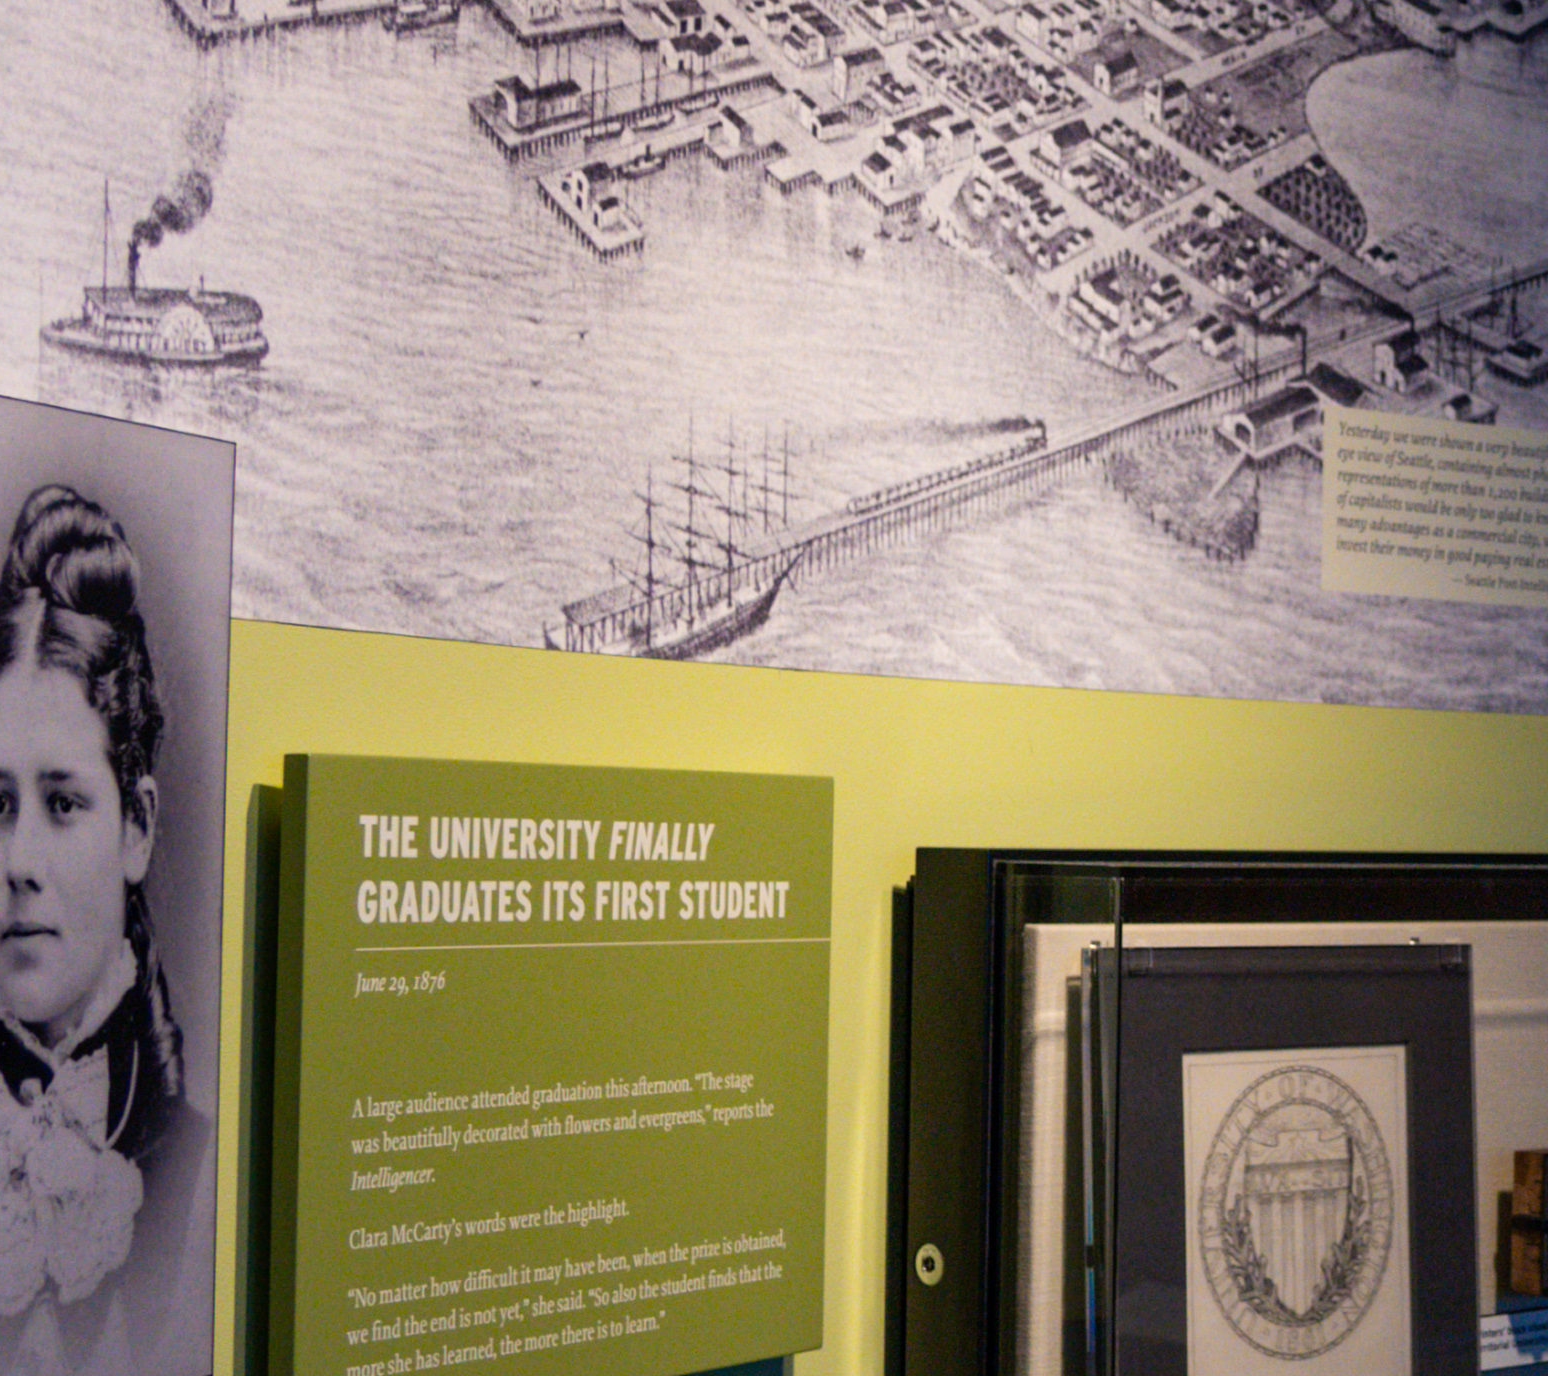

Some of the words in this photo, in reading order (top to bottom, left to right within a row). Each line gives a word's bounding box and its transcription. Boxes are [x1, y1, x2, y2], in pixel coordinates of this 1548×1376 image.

[1337, 448, 1354, 462] eye
[1357, 448, 1382, 463] view
[1384, 451, 1396, 466] of
[1397, 451, 1435, 471] Seattle,
[1338, 422, 1390, 444] Yesterday
[1393, 433, 1408, 443] we
[1411, 434, 1437, 446] were
[1485, 443, 1509, 458] very
[1337, 470, 1417, 491] representations
[1420, 476, 1432, 495] of
[1432, 481, 1458, 494] more
[1461, 481, 1485, 497] than
[1336, 491, 1347, 507] of
[1348, 493, 1402, 512] capitalists
[1405, 499, 1438, 515] would
[1440, 500, 1452, 516] be
[1453, 504, 1477, 521] only
[1336, 516, 1367, 531] many
[1370, 517, 1431, 539] advantages
[1370, 539, 1395, 555] their
[1397, 544, 1432, 562] money
[1446, 548, 1472, 566] good
[1474, 551, 1511, 569] paying
[359, 815, 418, 858] THE
[430, 817, 600, 860] UNIVERSITY
[609, 822, 714, 861] FINALLY
[357, 880, 531, 923] GRADUATES
[543, 881, 585, 921] ITS
[596, 881, 670, 920] FIRST
[679, 882, 789, 919] STUDENT
[354, 973, 385, 998] June
[389, 975, 409, 995] 29,
[413, 971, 445, 991] 1876
[352, 1099, 364, 1118] A
[367, 1097, 403, 1122] large
[406, 1092, 469, 1115] audience
[471, 1086, 530, 1109] attended
[532, 1080, 602, 1110] graduation
[606, 1078, 629, 1098] this
[632, 1077, 693, 1096] afternoon.
[695, 1072, 723, 1090] "The
[724, 1073, 754, 1093] stage
[352, 1138, 379, 1154] was
[383, 1126, 461, 1151] beautifully
[464, 1120, 529, 1144] decorated
[531, 1117, 562, 1138] with
[565, 1115, 611, 1135] flowers
[614, 1110, 636, 1131] and
[639, 1105, 711, 1131] evergreens,"
[713, 1104, 754, 1126] reports
[756, 1099, 774, 1118] the
[350, 1167, 436, 1193] Intelligencer.
[349, 1229, 388, 1249] Clara
[391, 1219, 462, 1245] McCarty's
[465, 1212, 506, 1235] words
[509, 1213, 541, 1230] were
[544, 1206, 565, 1225] the
[568, 1198, 629, 1227] highlight.
[348, 1287, 376, 1308] "No
[380, 1283, 428, 1304] matter
[430, 1277, 462, 1297] how
[464, 1266, 518, 1292] difficult
[521, 1265, 531, 1284] it
[534, 1265, 562, 1285] may
[565, 1259, 595, 1277] have
[598, 1254, 631, 1273] been,
[633, 1248, 666, 1268] when
[669, 1243, 688, 1262] the
[691, 1239, 720, 1265] prize
[723, 1237, 732, 1255] is
[734, 1229, 786, 1253] obtained,
[347, 1329, 368, 1345] we
[372, 1317, 401, 1341] find
[405, 1315, 428, 1337] the
[430, 1309, 456, 1332] end
[460, 1308, 471, 1328] is
[474, 1307, 497, 1326] not
[500, 1298, 530, 1327] yet,"
[532, 1296, 555, 1317] she
[557, 1291, 586, 1312] said.
[589, 1288, 610, 1307] "So
[612, 1284, 636, 1304] also
[639, 1280, 659, 1300] the
[661, 1274, 706, 1296] student
[708, 1268, 736, 1289] finds
[739, 1264, 763, 1284] that
[764, 1261, 783, 1280] the
[388, 1353, 412, 1375] she
[416, 1350, 440, 1371] has
[442, 1338, 497, 1366] learned,
[500, 1335, 522, 1356] the
[524, 1333, 559, 1352] more
[562, 1325, 595, 1345] there
[597, 1321, 608, 1339] is
[611, 1321, 623, 1337] to
[625, 1310, 665, 1334] learn."
